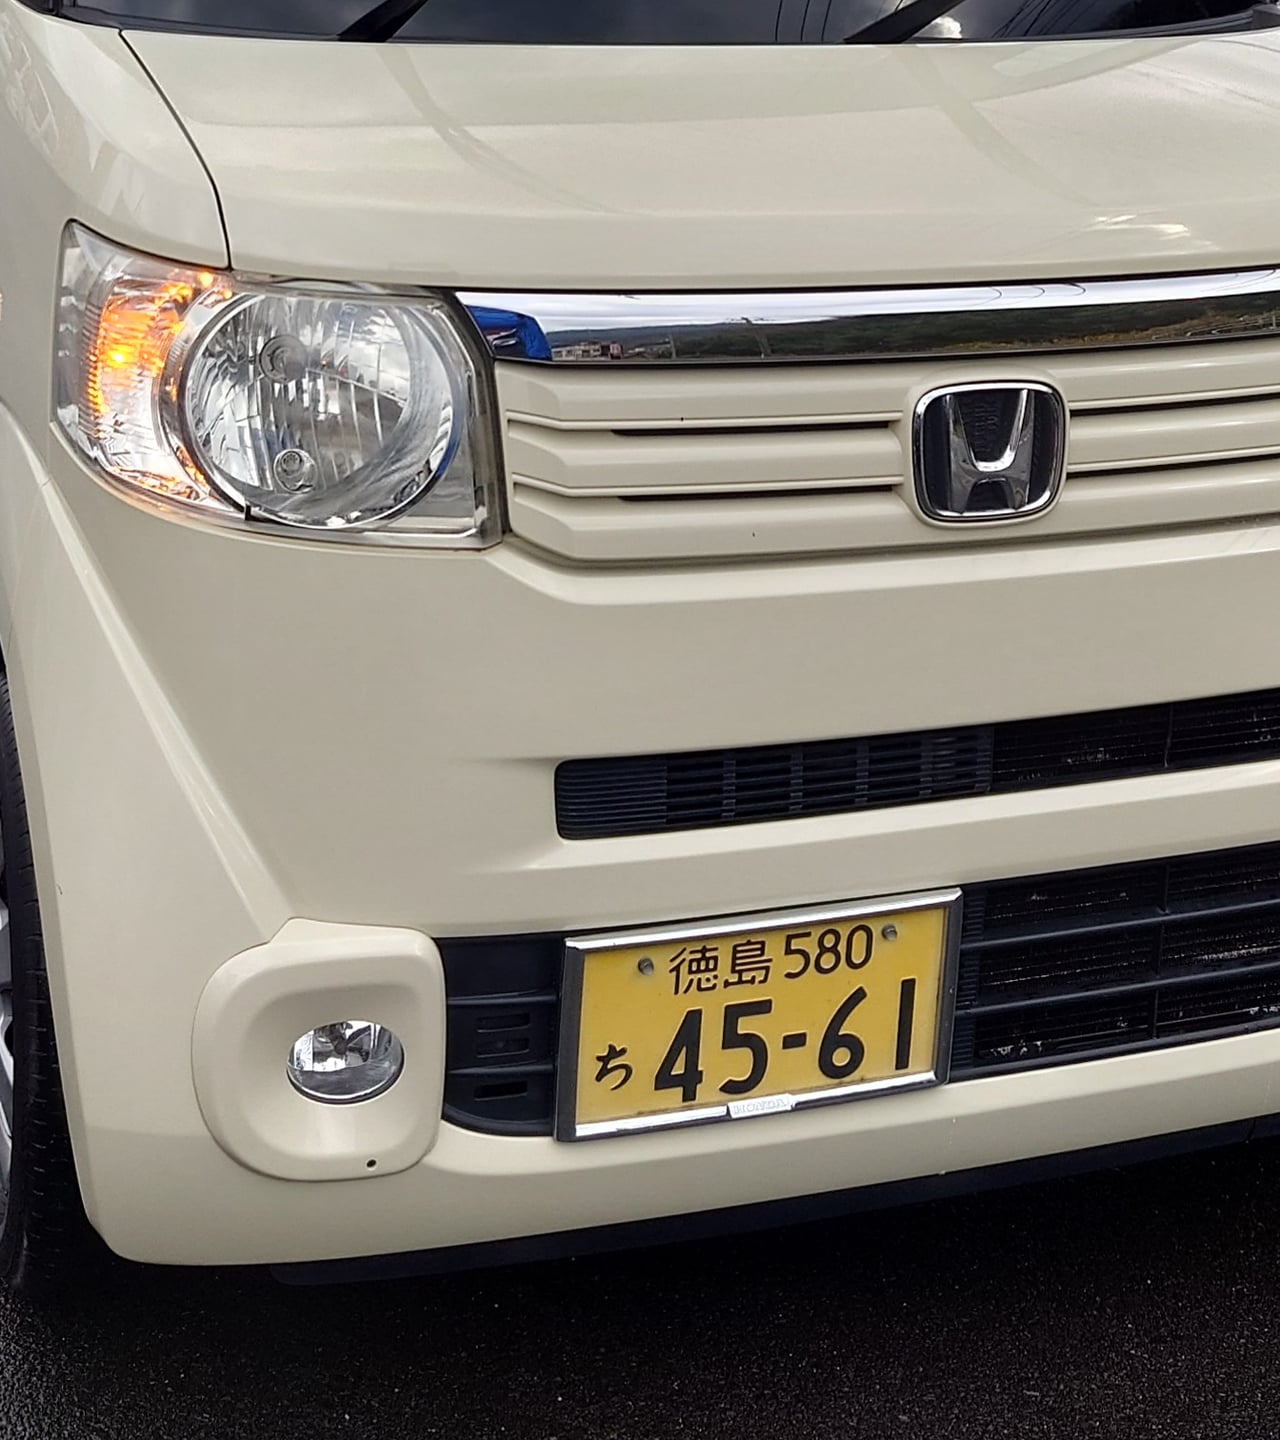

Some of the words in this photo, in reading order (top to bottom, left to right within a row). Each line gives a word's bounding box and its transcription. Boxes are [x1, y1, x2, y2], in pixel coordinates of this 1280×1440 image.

[668, 939, 773, 996] 徳島
[784, 924, 874, 980] 580
[595, 1044, 633, 1091] ち
[653, 978, 916, 1104] 45-61
